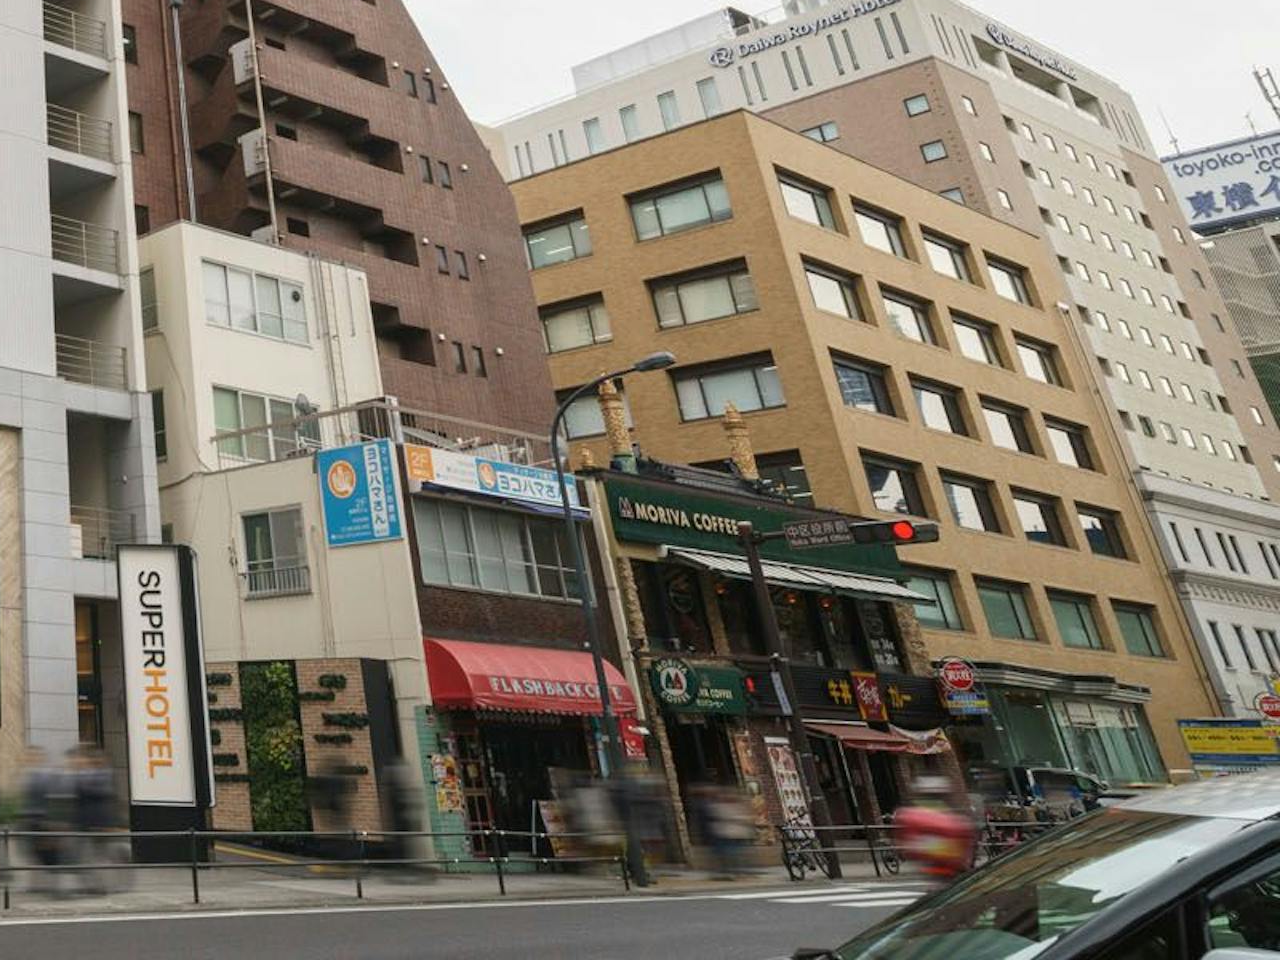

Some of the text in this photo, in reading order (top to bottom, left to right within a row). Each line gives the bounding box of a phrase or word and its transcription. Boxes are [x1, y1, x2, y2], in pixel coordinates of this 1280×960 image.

[738, 34, 787, 58] Daiwa
[788, 9, 850, 40] Roynet
[367, 447, 386, 525] ヨコハマさん
[634, 502, 739, 536] MORIVA COFFEE
[489, 676, 585, 699] FLASHBACK
